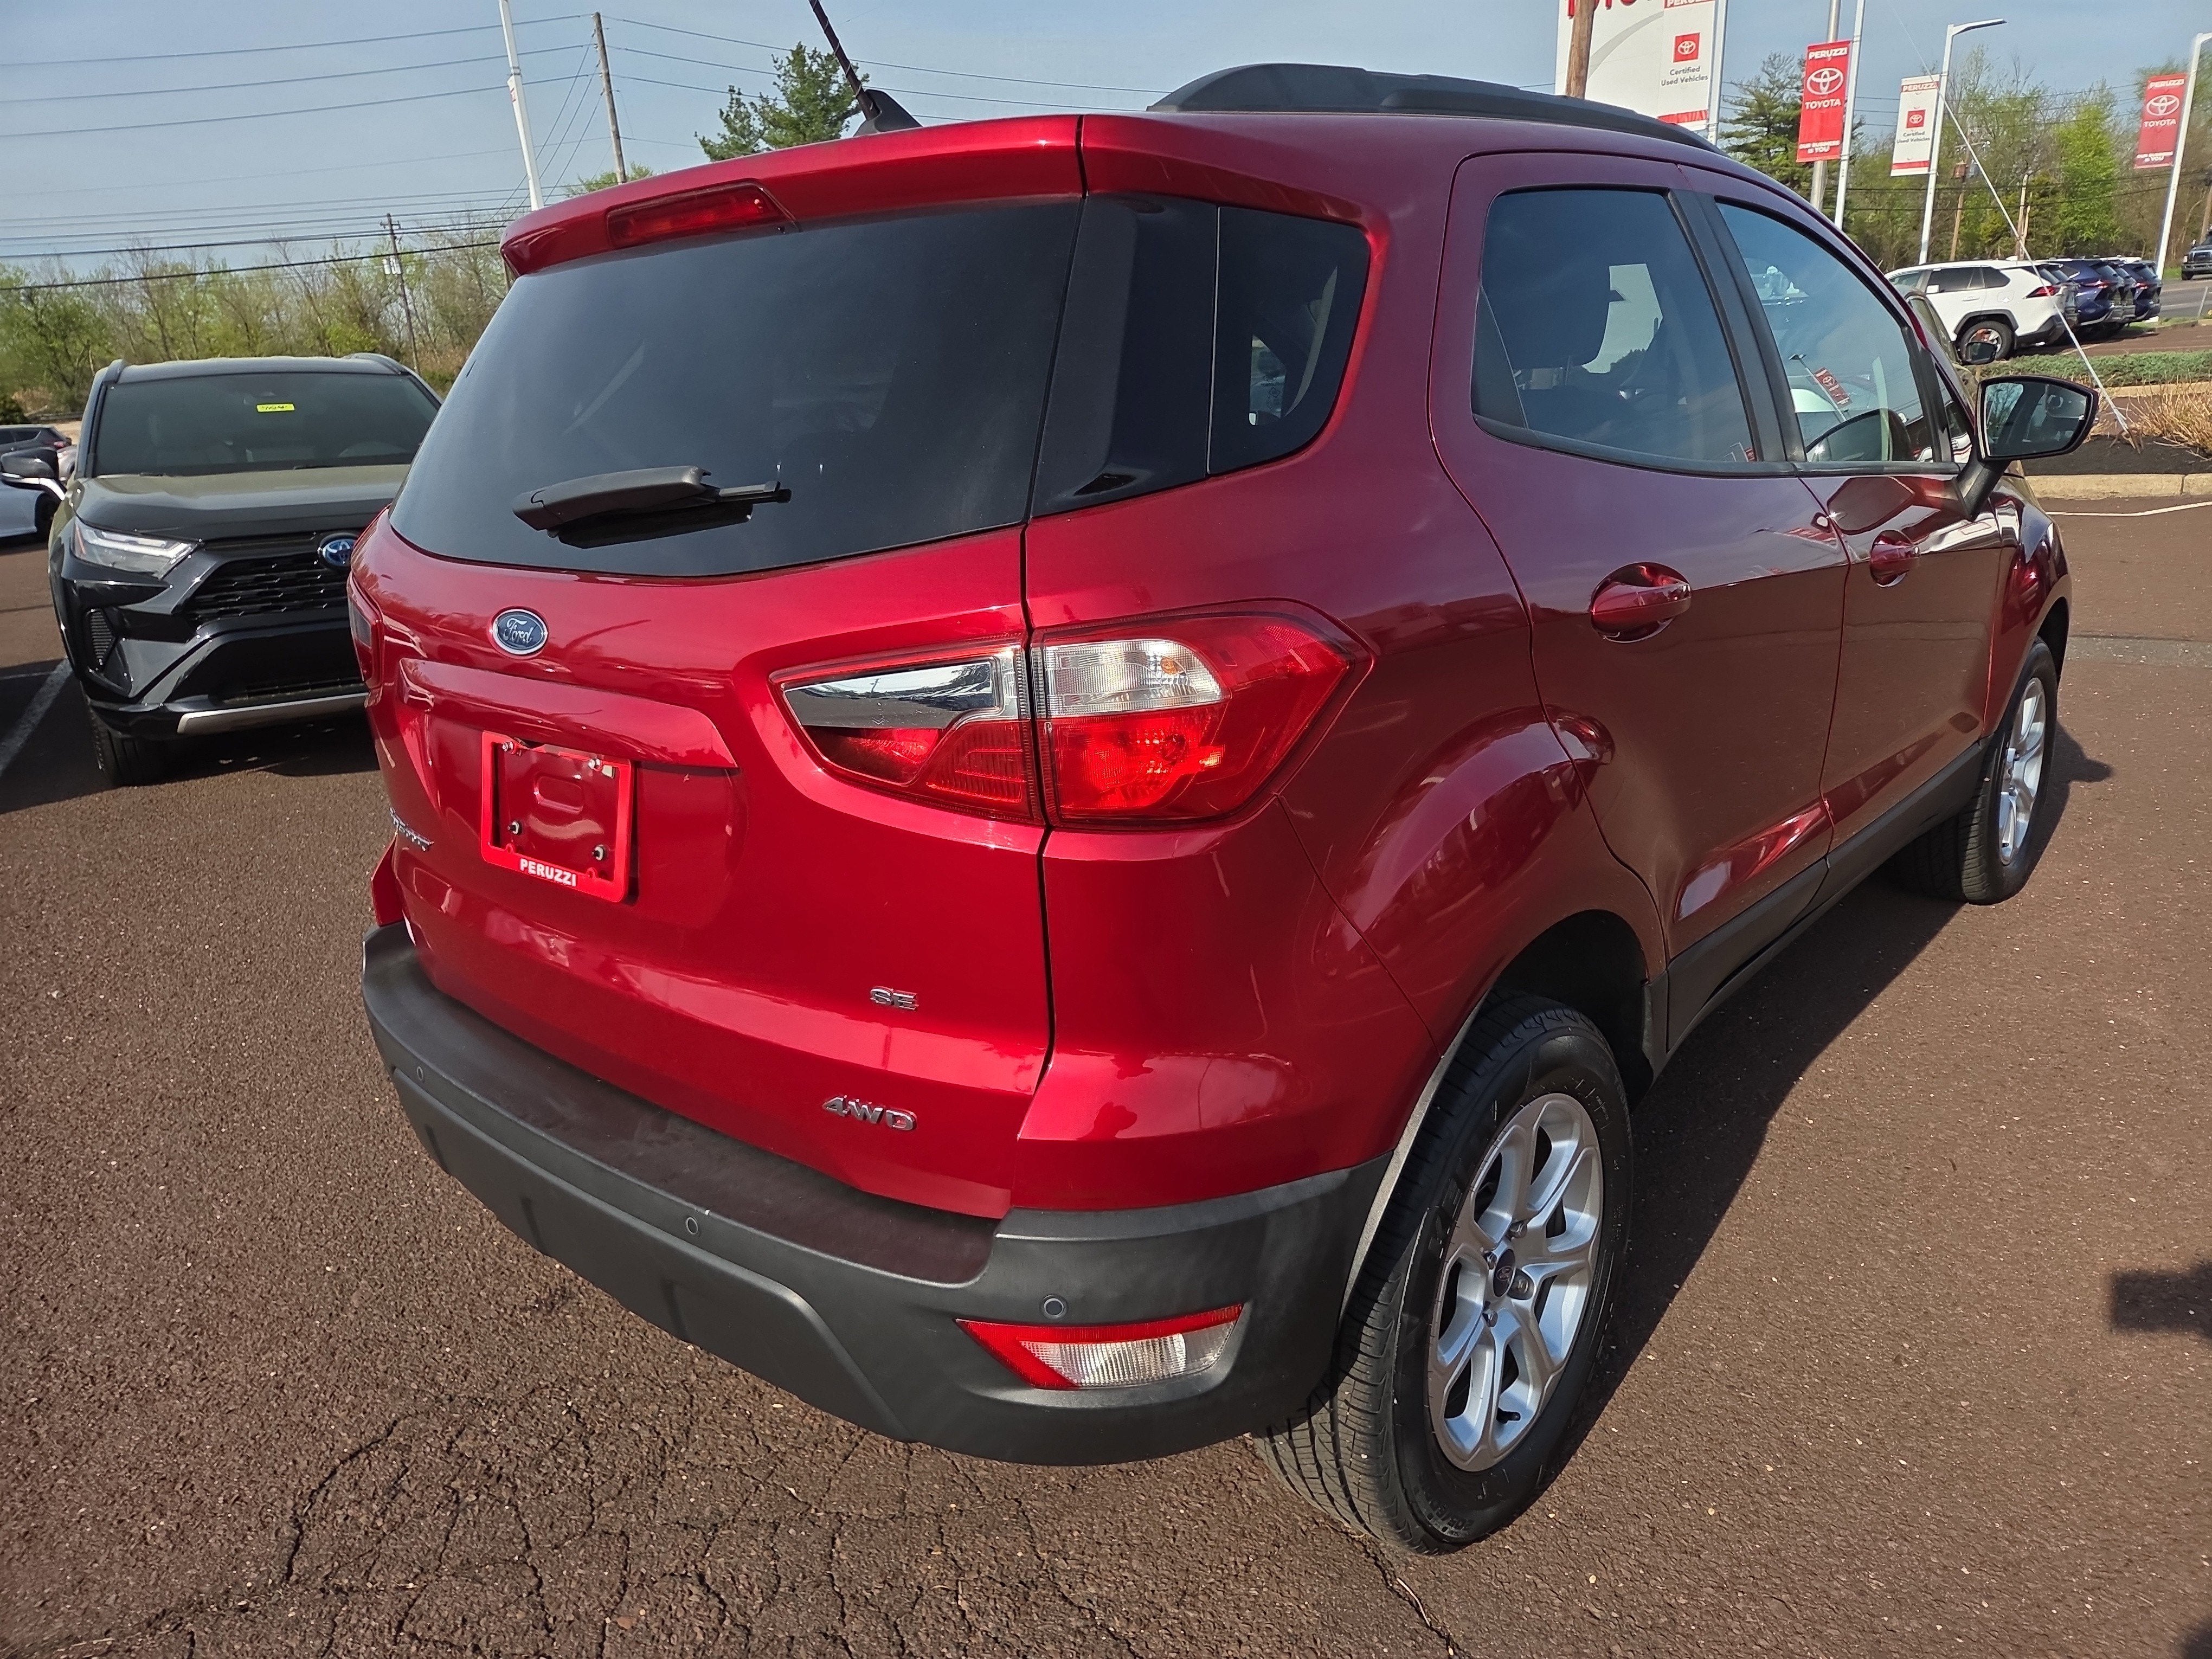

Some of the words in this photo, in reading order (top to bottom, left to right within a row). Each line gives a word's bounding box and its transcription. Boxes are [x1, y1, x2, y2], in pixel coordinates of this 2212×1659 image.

[1809, 47, 1848, 60] PERUZZI
[1669, 66, 1701, 76] Certified
[1661, 78, 1679, 86] Used
[1680, 74, 1708, 83] Vehicles
[1805, 98, 1842, 110] TOYOTA
[2144, 119, 2176, 127] TOYOTA
[504, 618, 533, 644] Ford
[520, 858, 577, 887] PERUZZI
[870, 986, 919, 1012] SE
[822, 1095, 917, 1131] 4WD
